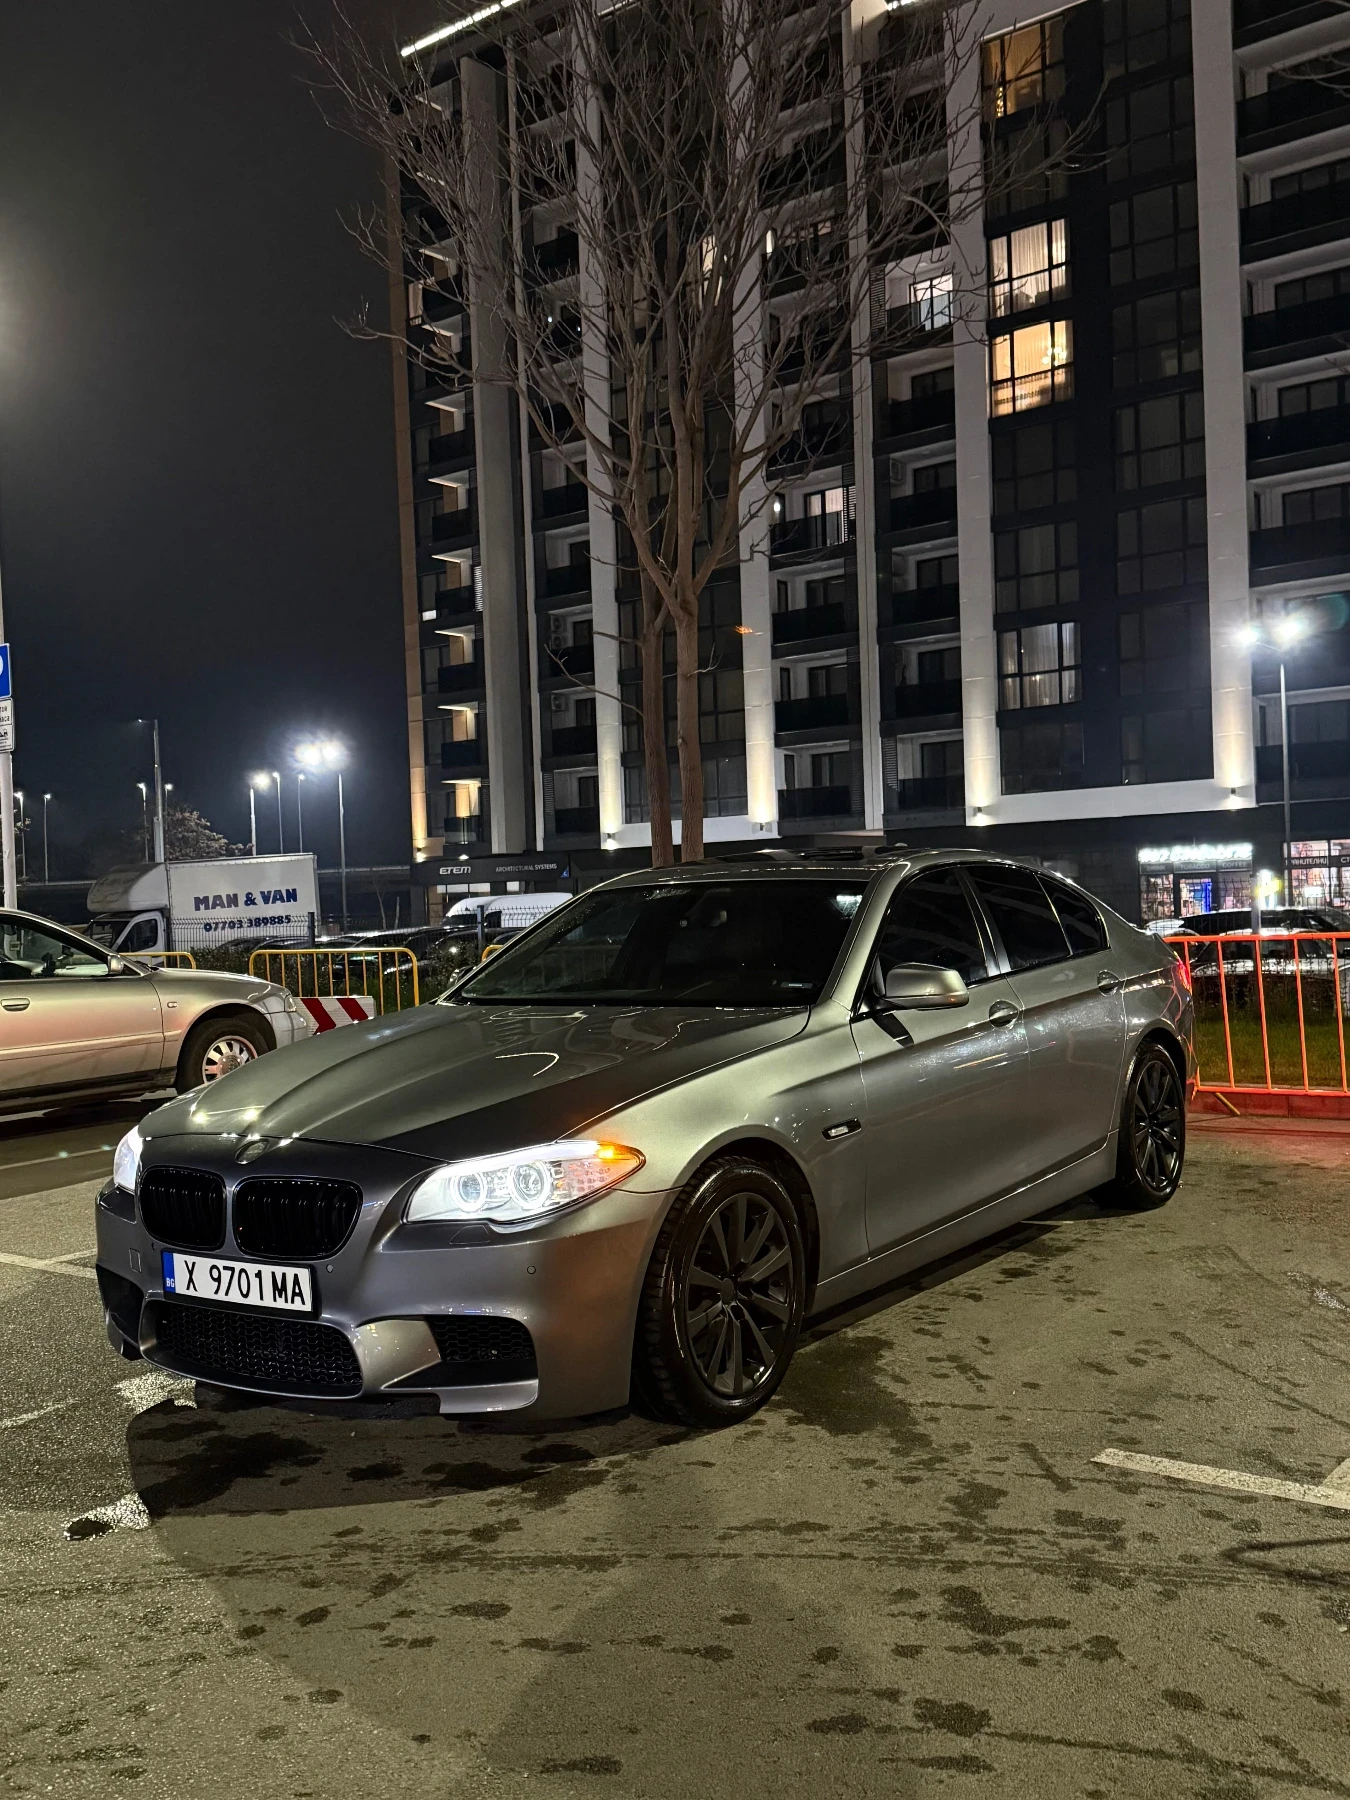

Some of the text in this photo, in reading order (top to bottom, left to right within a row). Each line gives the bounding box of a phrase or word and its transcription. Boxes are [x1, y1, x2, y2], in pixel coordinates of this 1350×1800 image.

[495, 863, 557, 873] ARCHITECTURAL SYSTEMS
[1222, 860, 1248, 868] COFFEE
[439, 866, 471, 875] ETEM
[193, 888, 298, 911] MAN & VAN
[204, 915, 291, 932] 07703 389885
[166, 1277, 175, 1288] BG
[184, 1260, 306, 1306] X 9701 MA
